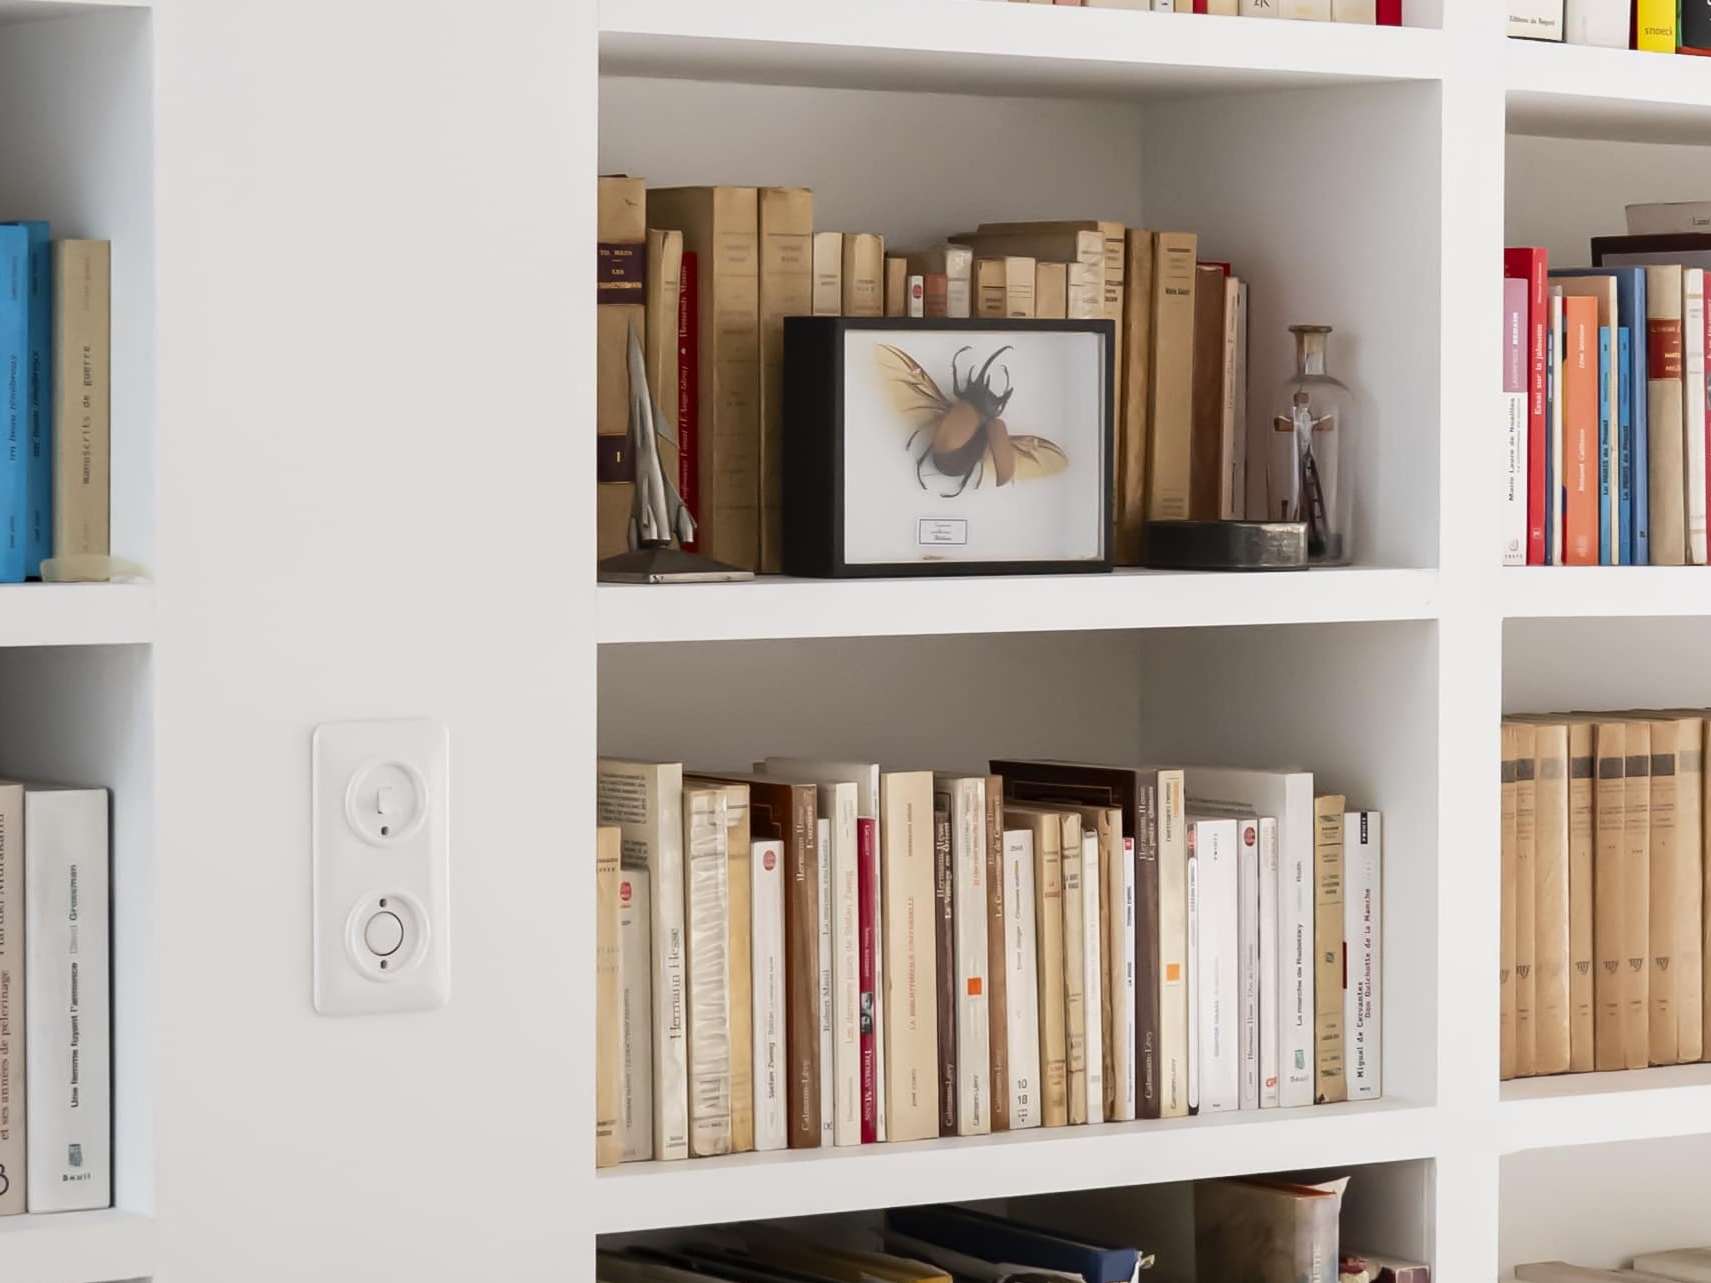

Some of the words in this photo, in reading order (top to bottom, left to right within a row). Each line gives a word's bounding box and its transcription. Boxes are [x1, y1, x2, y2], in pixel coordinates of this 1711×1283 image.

[81, 345, 93, 386] guerre
[81, 394, 92, 408] de
[81, 415, 92, 485] manuscrits
[669, 927, 682, 969] Hesse
[669, 974, 682, 1041] Hermann
[1017, 1079, 1028, 1090] 10
[1017, 1094, 1029, 1105] 18
